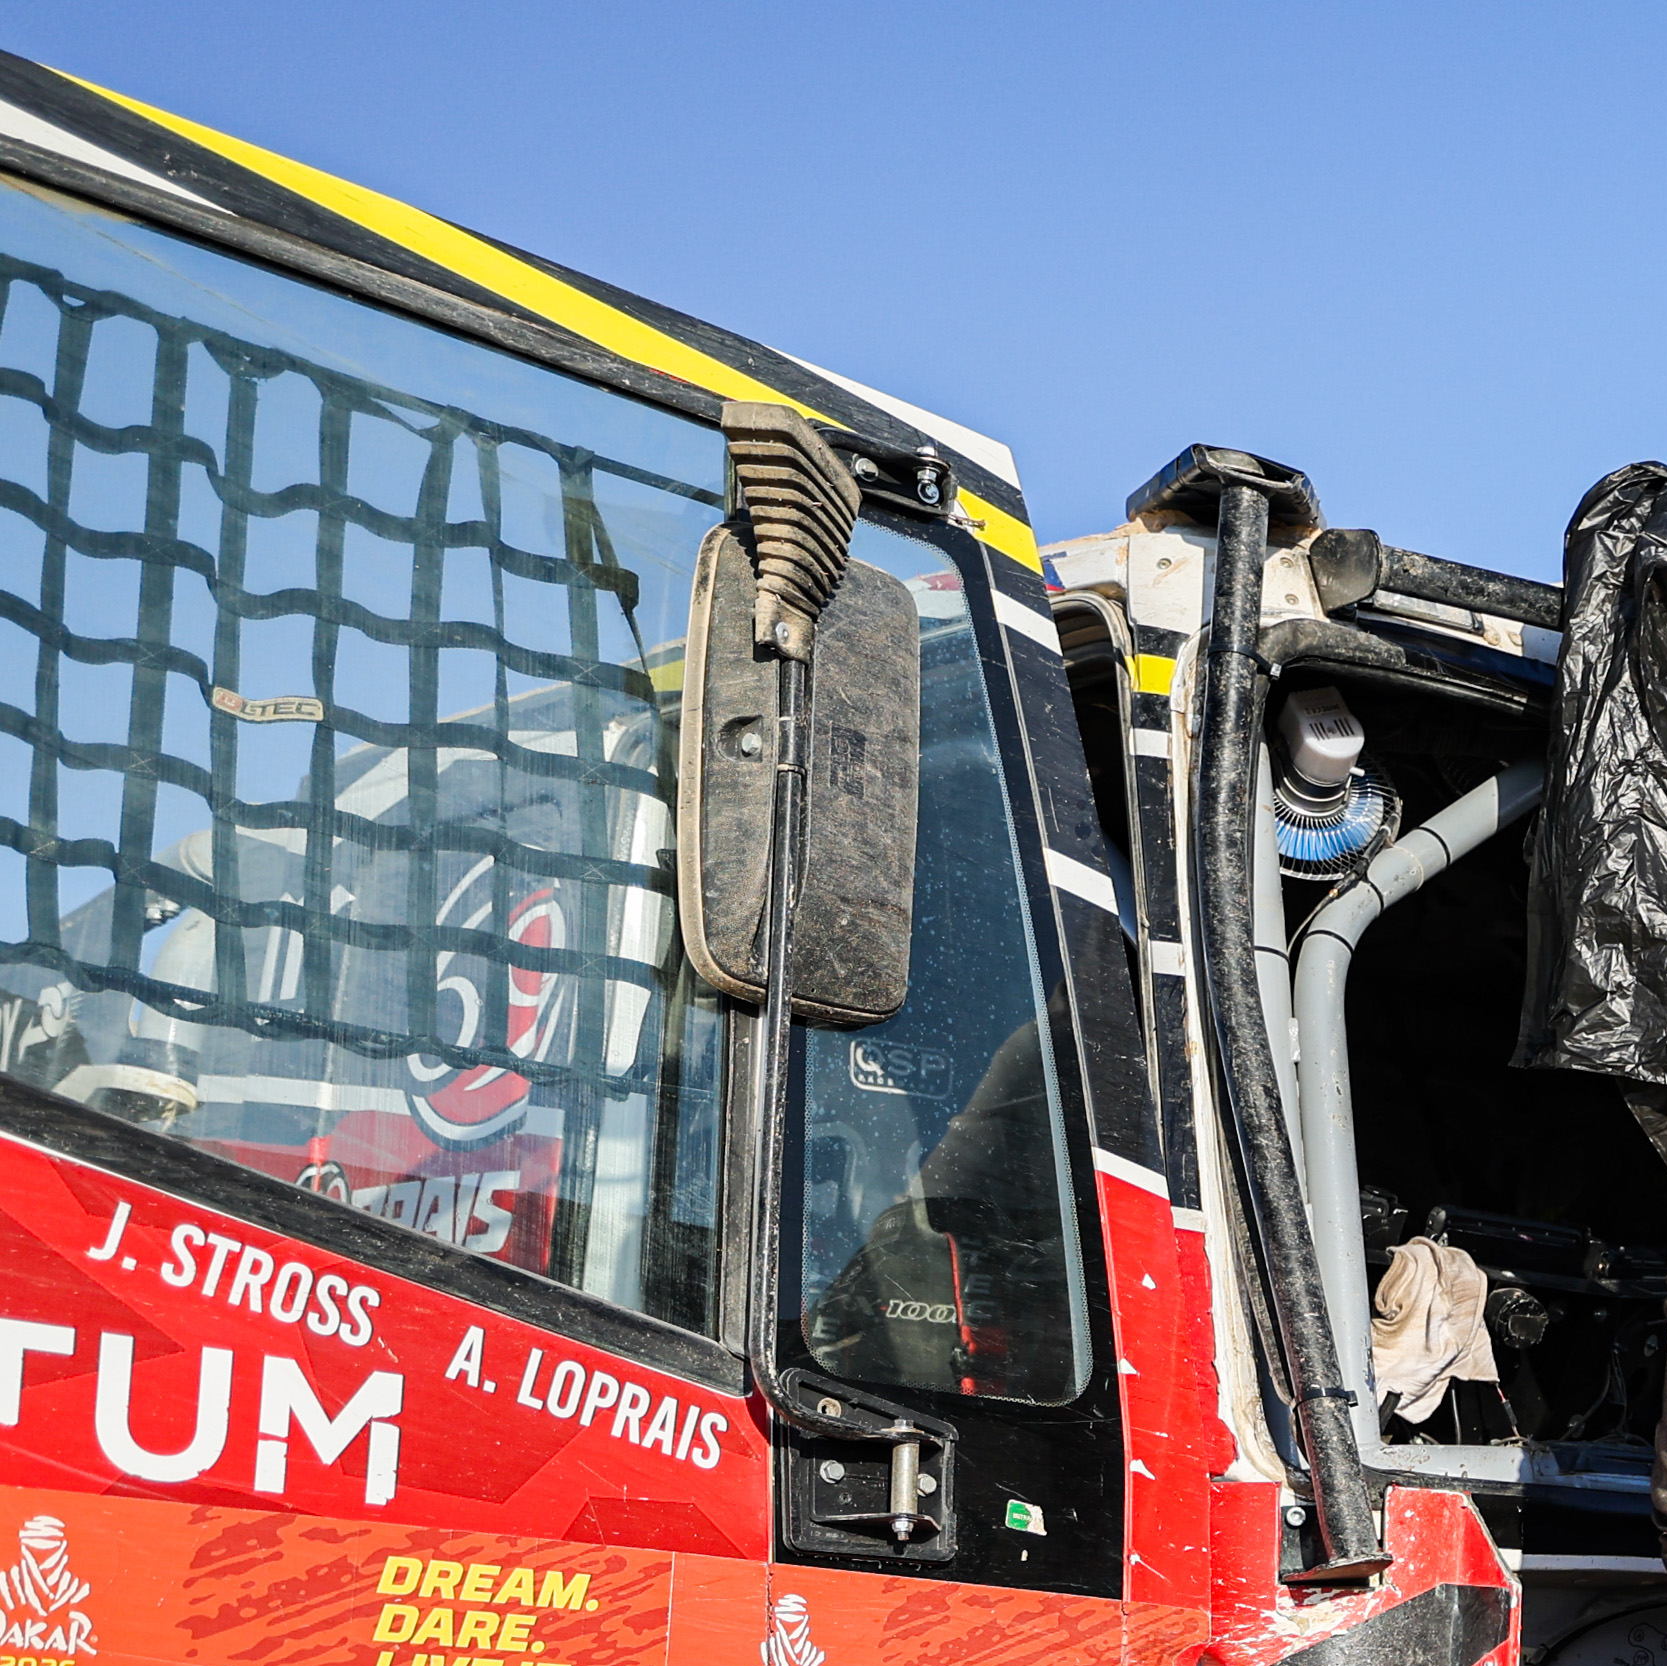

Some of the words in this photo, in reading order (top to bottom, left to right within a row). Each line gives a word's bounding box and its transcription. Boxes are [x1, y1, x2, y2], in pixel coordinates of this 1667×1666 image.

[86, 1202, 137, 1271] J.
[160, 1223, 381, 1347] STROSS
[444, 1326, 498, 1394] A.
[517, 1347, 730, 1471] LOPRAIS
[377, 1556, 600, 1612] DREAM.
[0, 1611, 96, 1656] AKAR
[373, 1603, 545, 1654] DARE.
